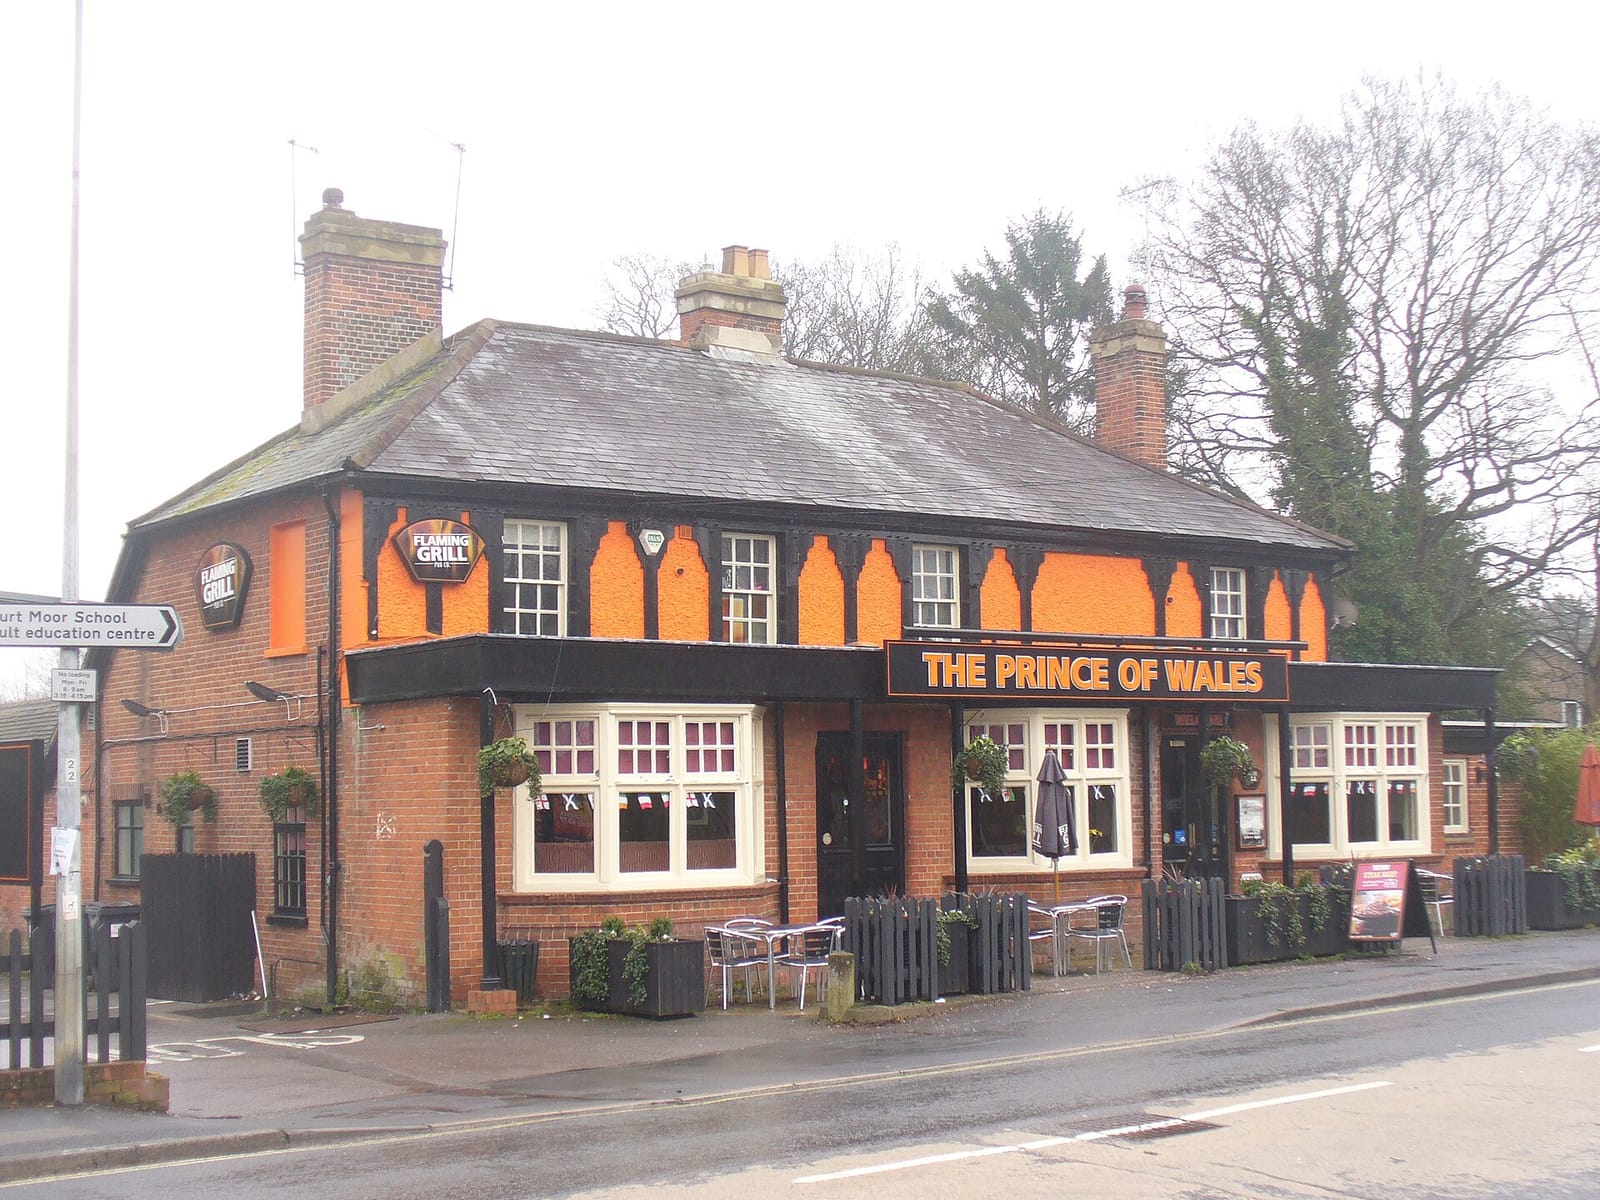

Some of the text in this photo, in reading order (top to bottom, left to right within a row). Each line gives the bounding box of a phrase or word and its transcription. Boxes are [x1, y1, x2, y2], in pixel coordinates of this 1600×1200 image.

[413, 535, 470, 546] FLAMING
[416, 546, 467, 561] GRILL
[201, 559, 236, 584] FLAMING
[203, 576, 234, 603] GRILL
[29, 611, 67, 623] Moor
[74, 611, 127, 624] School
[25, 626, 101, 640] education
[106, 628, 156, 640] centre
[922, 652, 1264, 693] THE PRINCE OF WALES
